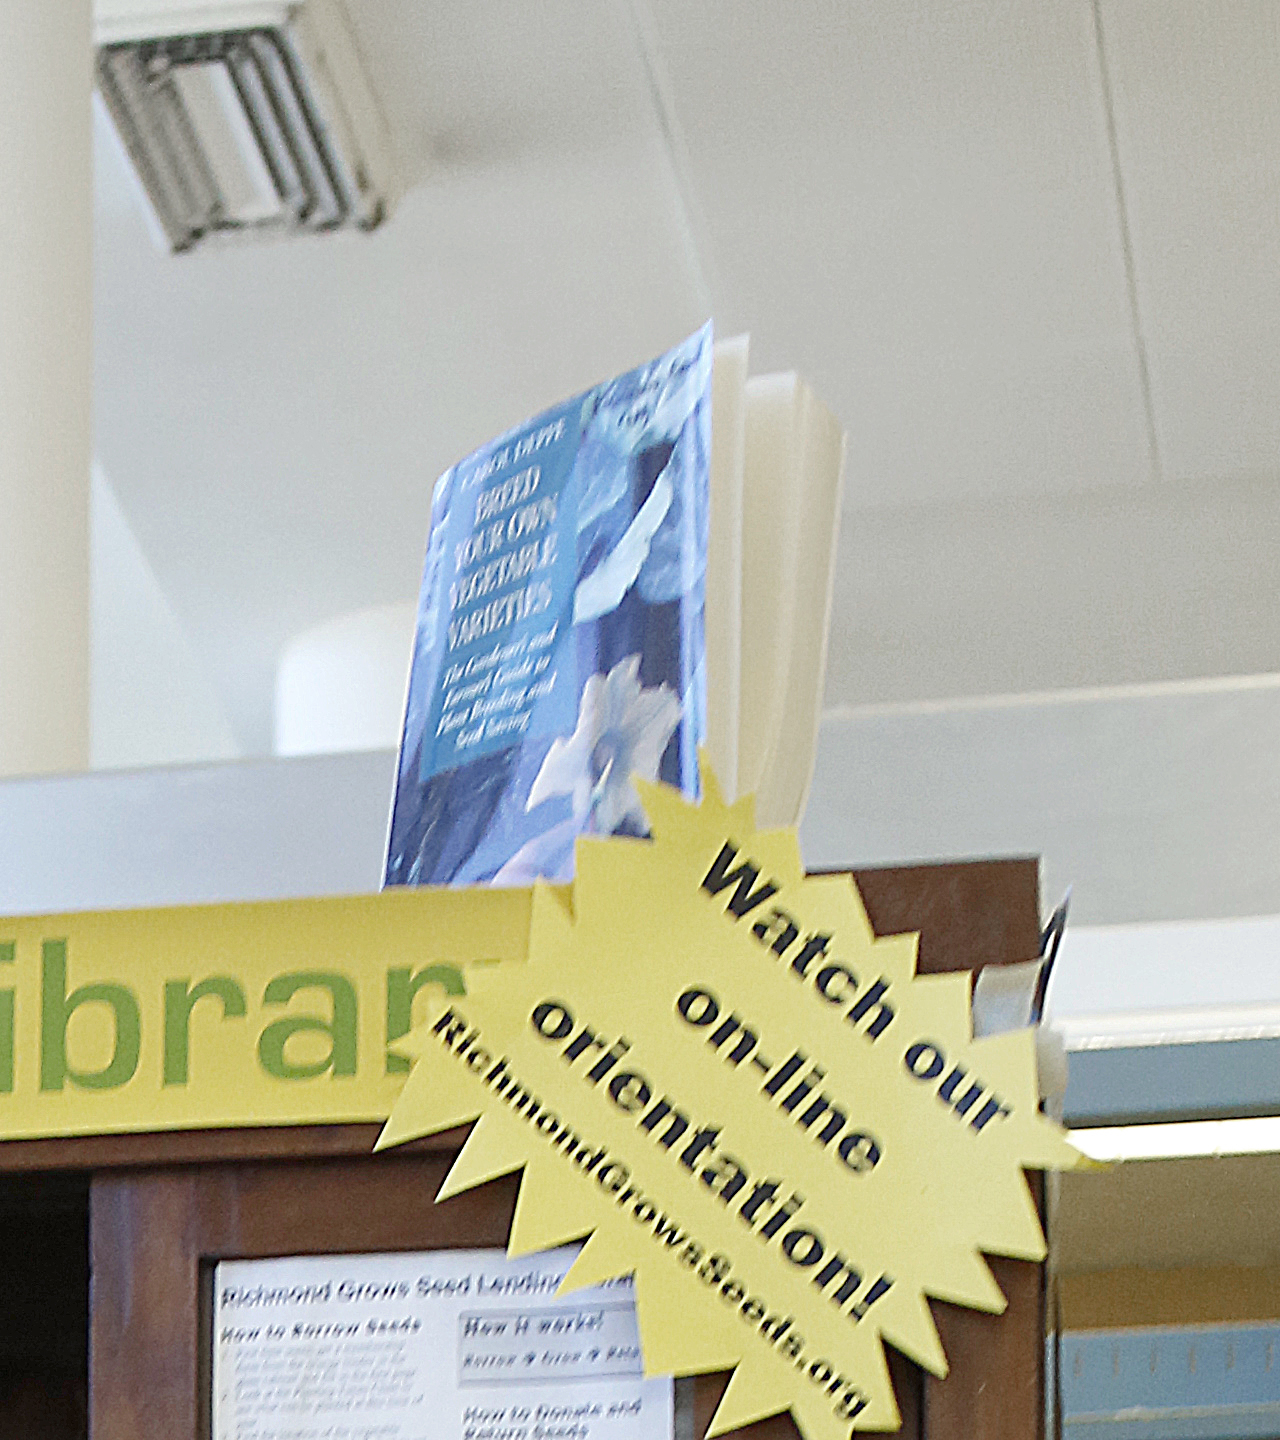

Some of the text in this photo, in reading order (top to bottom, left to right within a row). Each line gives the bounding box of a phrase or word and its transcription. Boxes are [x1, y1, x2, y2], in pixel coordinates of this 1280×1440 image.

[676, 984, 884, 1176] on-line
[698, 840, 1012, 1136] Watch our
[430, 1005, 873, 1421] RichmondGrowsSeeds.org
[530, 1000, 897, 1323] orientation!
